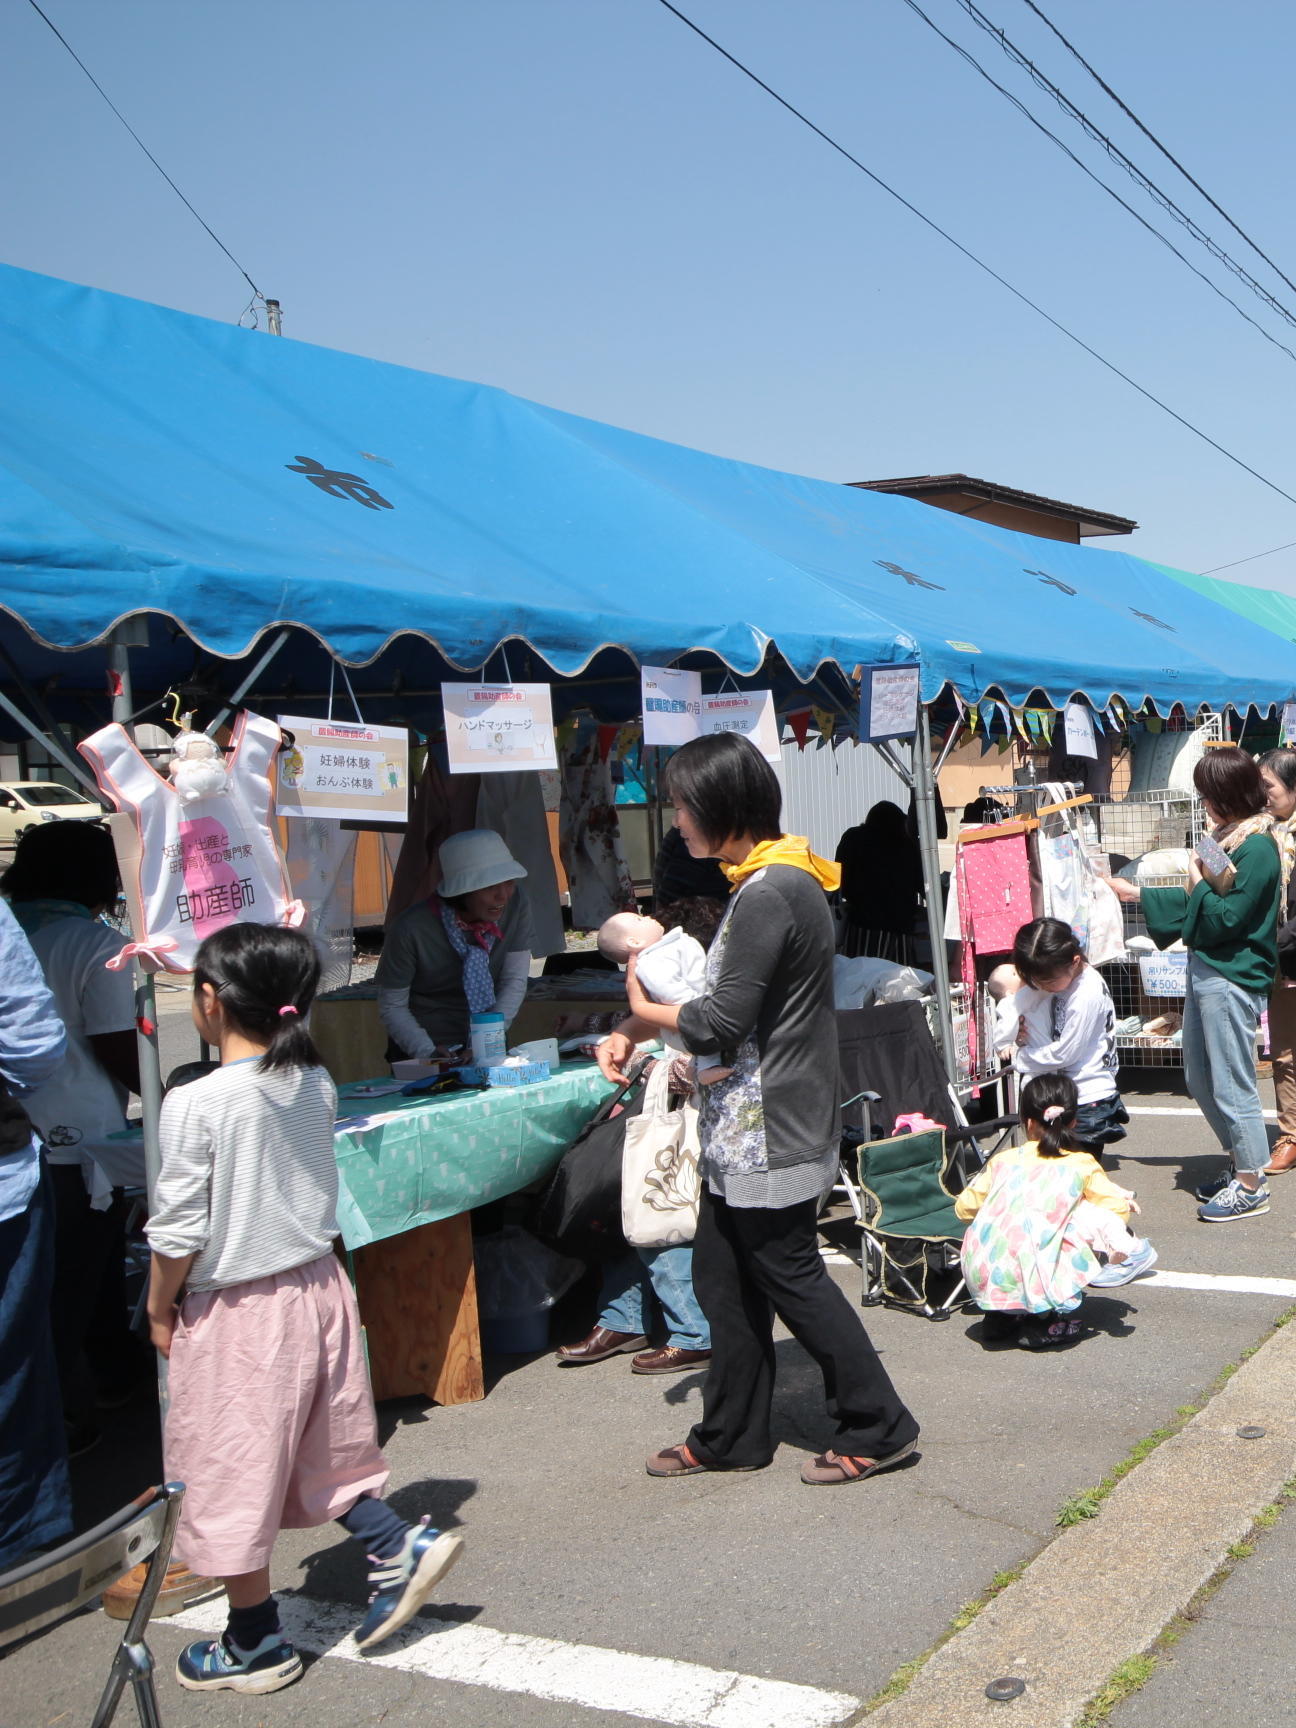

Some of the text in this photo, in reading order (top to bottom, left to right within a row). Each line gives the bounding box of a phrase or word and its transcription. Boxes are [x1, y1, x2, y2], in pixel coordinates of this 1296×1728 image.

[458, 719, 533, 731] ハンドマッサージ
[319, 753, 371, 770] 妊婦体験
[316, 775, 374, 790] おんぶ体験
[176, 877, 255, 923] 助産師
